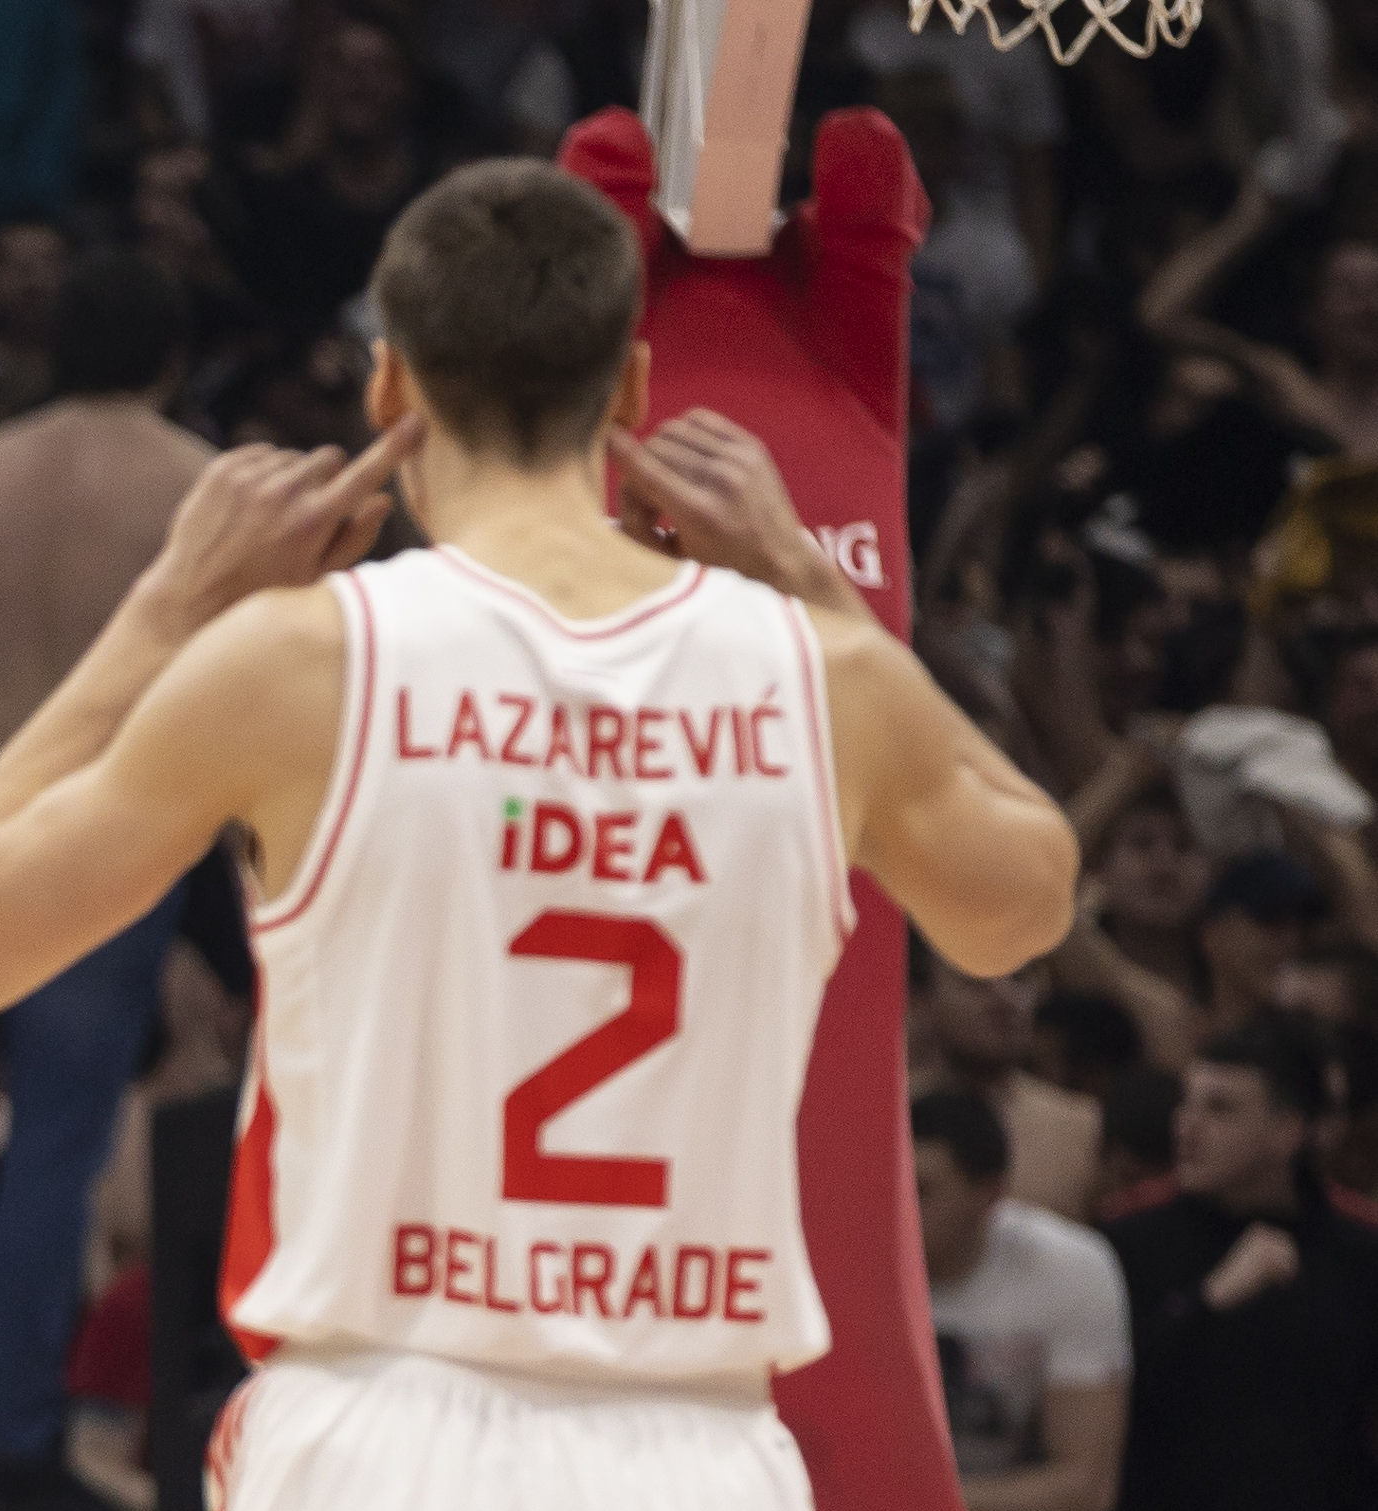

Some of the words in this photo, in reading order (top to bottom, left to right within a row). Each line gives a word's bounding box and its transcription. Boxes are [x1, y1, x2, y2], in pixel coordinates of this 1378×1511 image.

[396, 682, 790, 783] LAZAREVIĆ
[501, 908, 684, 1208] 2
[390, 1223, 773, 1324] BELGRADE
